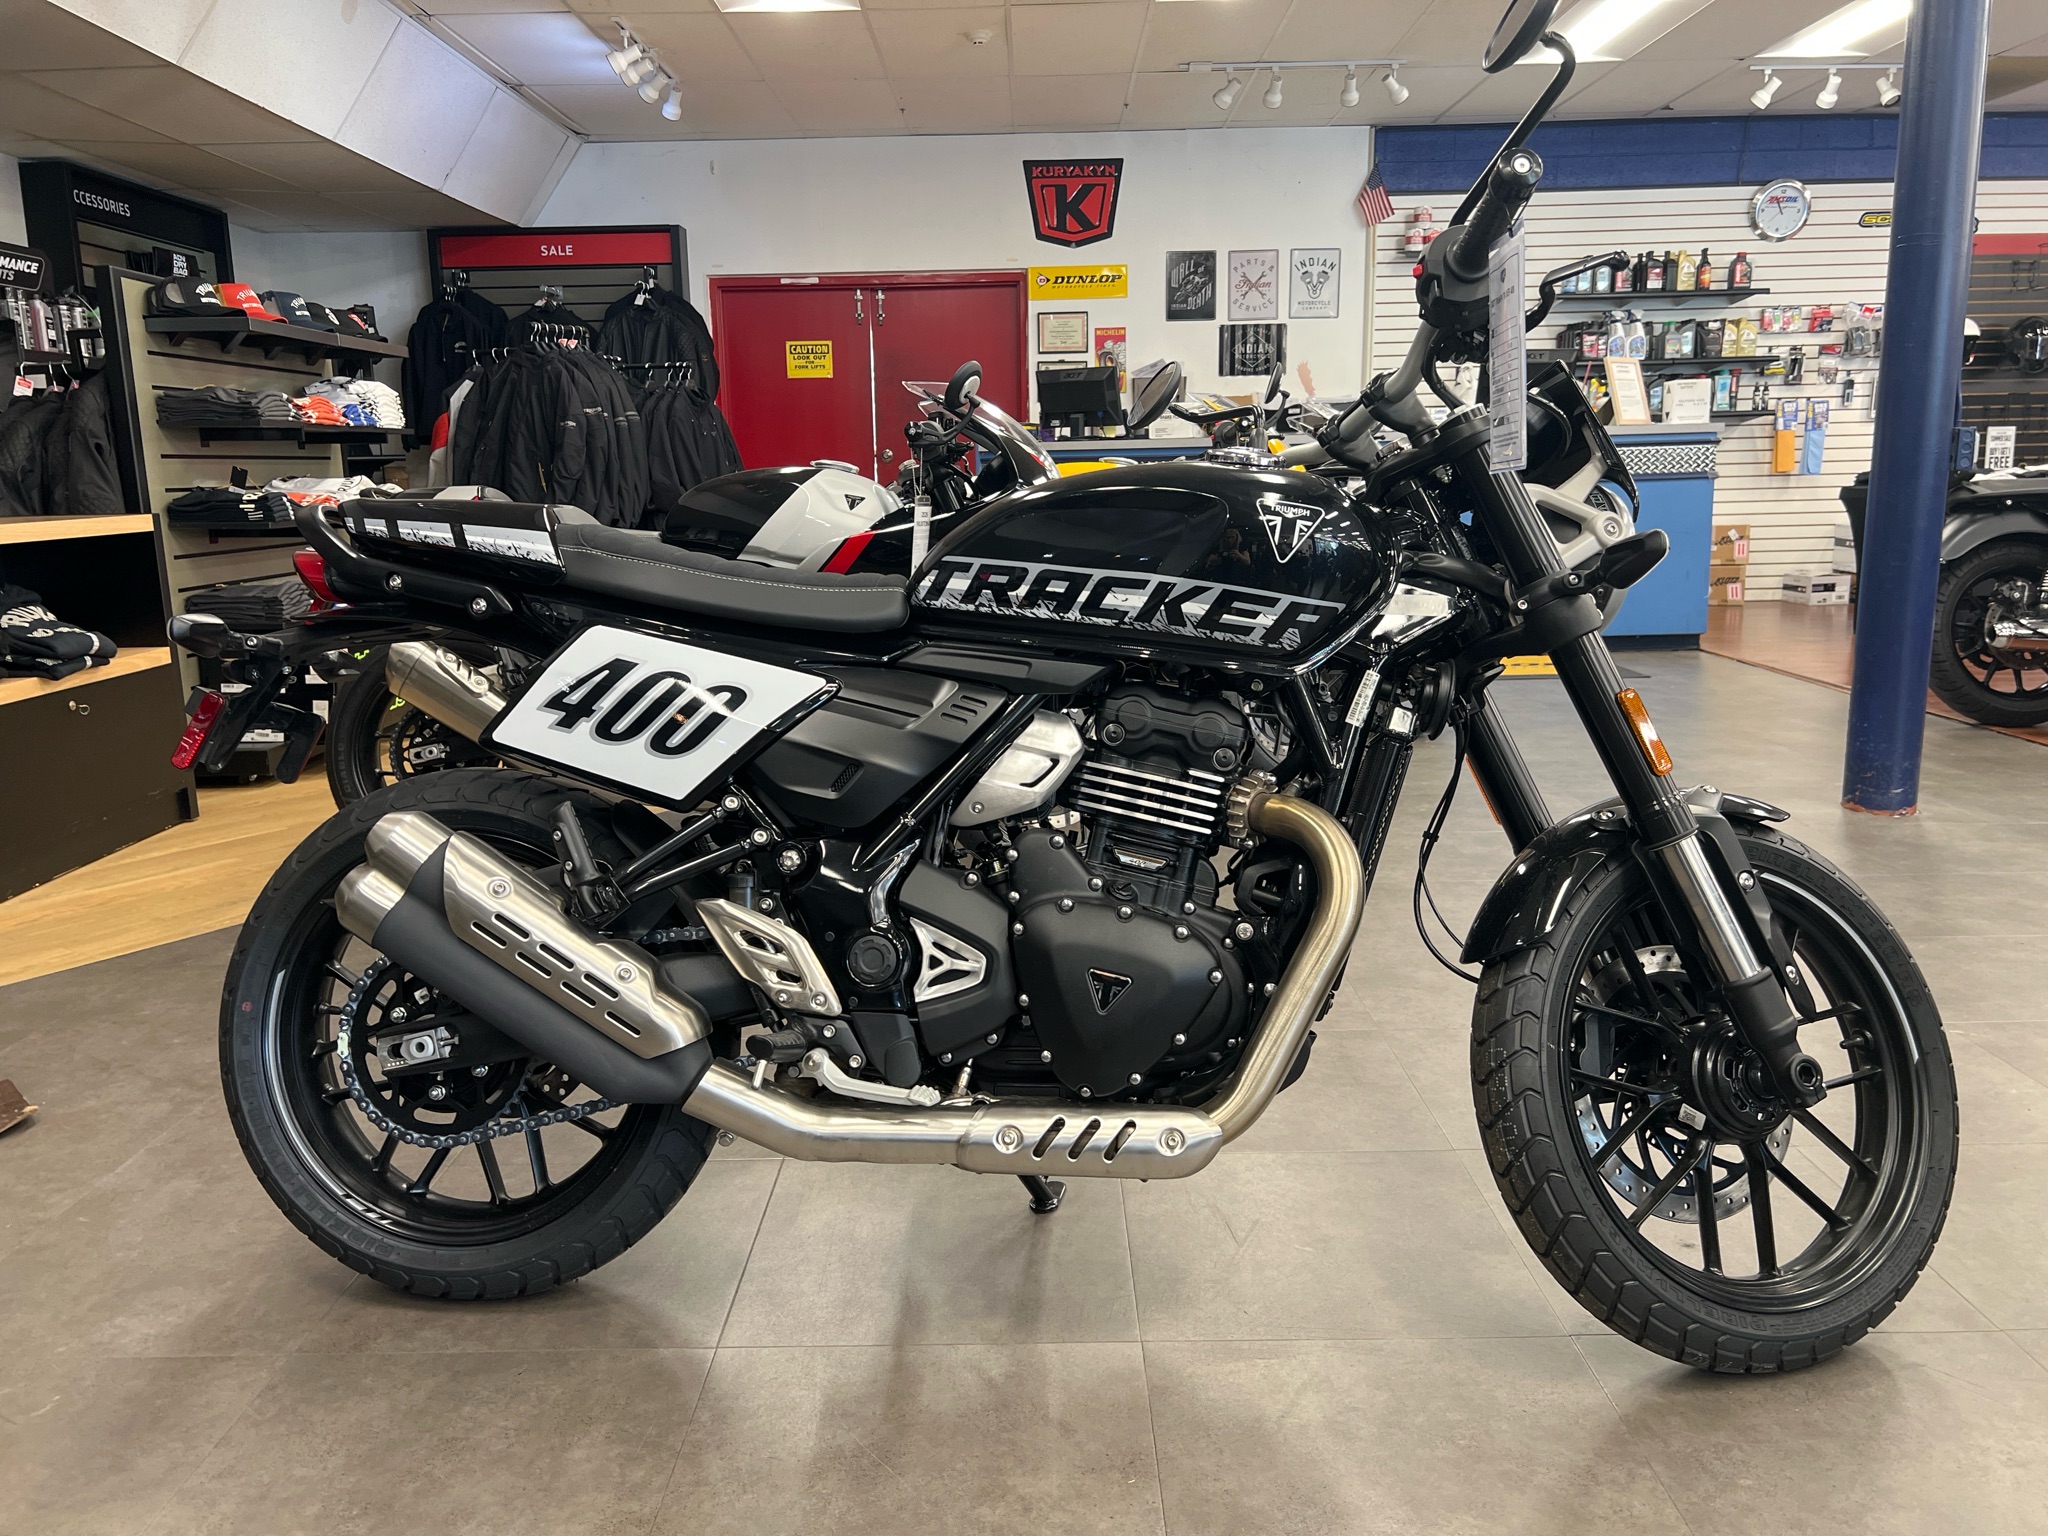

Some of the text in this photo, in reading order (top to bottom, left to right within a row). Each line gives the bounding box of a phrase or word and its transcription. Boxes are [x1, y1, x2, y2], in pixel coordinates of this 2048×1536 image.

[1031, 165, 1116, 177] KURYAKYN
[73, 189, 130, 217] CCESSORIES
[1766, 195, 1799, 204] AMSOIL
[540, 244, 574, 256] SALE
[173, 260, 187, 269] DRY
[173, 266, 188, 276] BAG
[1233, 258, 1266, 273] PARTS
[1294, 257, 1337, 272] INDIAN
[1052, 274, 1123, 285] DUNLOP
[1171, 259, 1195, 287] WALL
[1235, 277, 1272, 289] Indian
[1187, 282, 1212, 310] DEATH
[1232, 298, 1275, 313] SERVICE
[1096, 328, 1125, 336] MICHELIN
[791, 345, 829, 354] CAUTION
[1235, 343, 1272, 353] INDIAN
[1063, 371, 1082, 379] acer
[1989, 456, 2010, 469] FREE
[1270, 504, 1311, 518] TRIUMPH
[920, 559, 1341, 646] TRACKER
[539, 656, 750, 757] 400
[1744, 844, 1839, 898] PIRELLI
[290, 1182, 397, 1258] PIRELLI
[1657, 1276, 1768, 1333] PIRELLI
